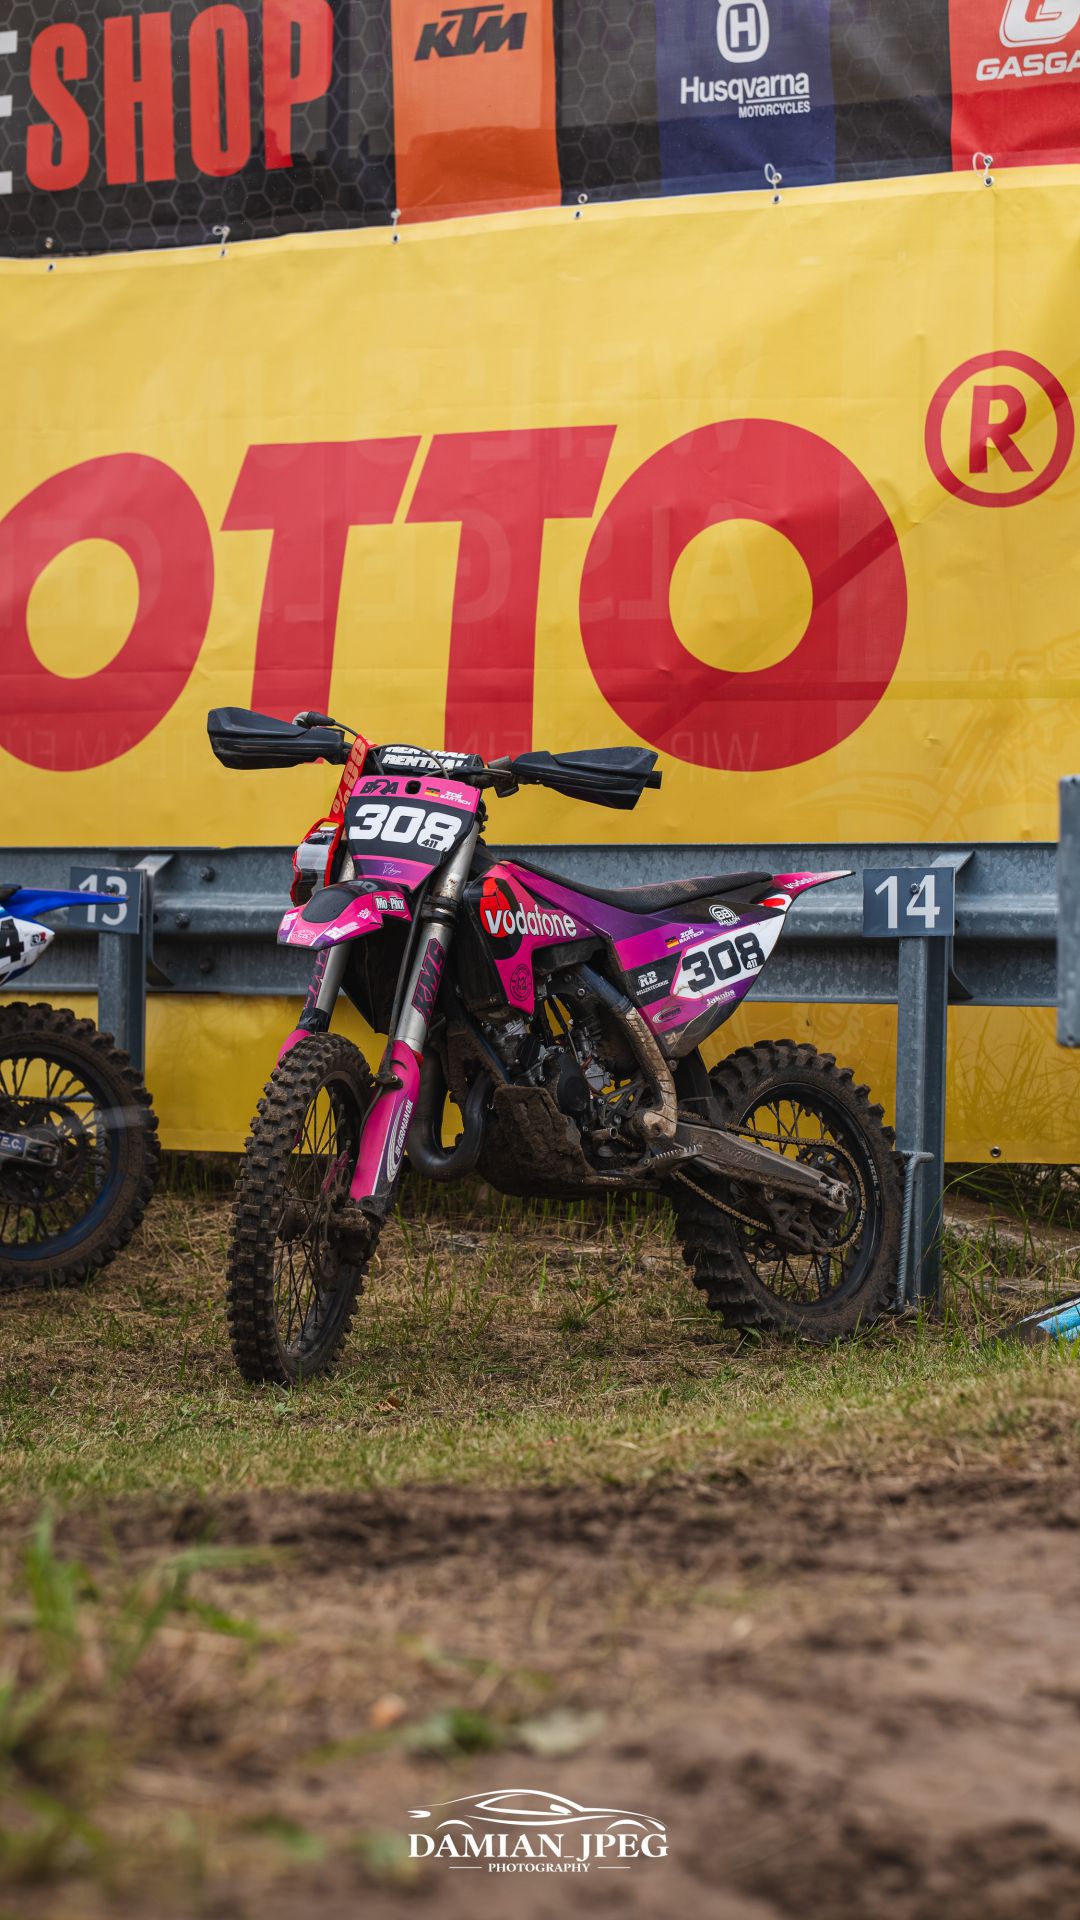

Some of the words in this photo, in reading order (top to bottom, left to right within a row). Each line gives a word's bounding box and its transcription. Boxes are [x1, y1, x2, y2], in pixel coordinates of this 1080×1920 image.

[414, 6, 528, 61] KTM
[976, 49, 1080, 81] GASGA
[26, 0, 335, 191] SHOP
[680, 72, 810, 105] Husqvarna
[738, 101, 811, 119] MOTORCYCLES
[0, 418, 908, 773] OTTO
[381, 754, 464, 770] RENTHAL
[349, 804, 463, 851] 308
[421, 839, 438, 849] 411
[79, 874, 128, 926] 13
[874, 874, 941, 929] 14
[484, 903, 577, 937] vodafone
[681, 932, 766, 992] 308
[746, 959, 758, 969] 411
[0, 1136, 22, 1150] E.C.
